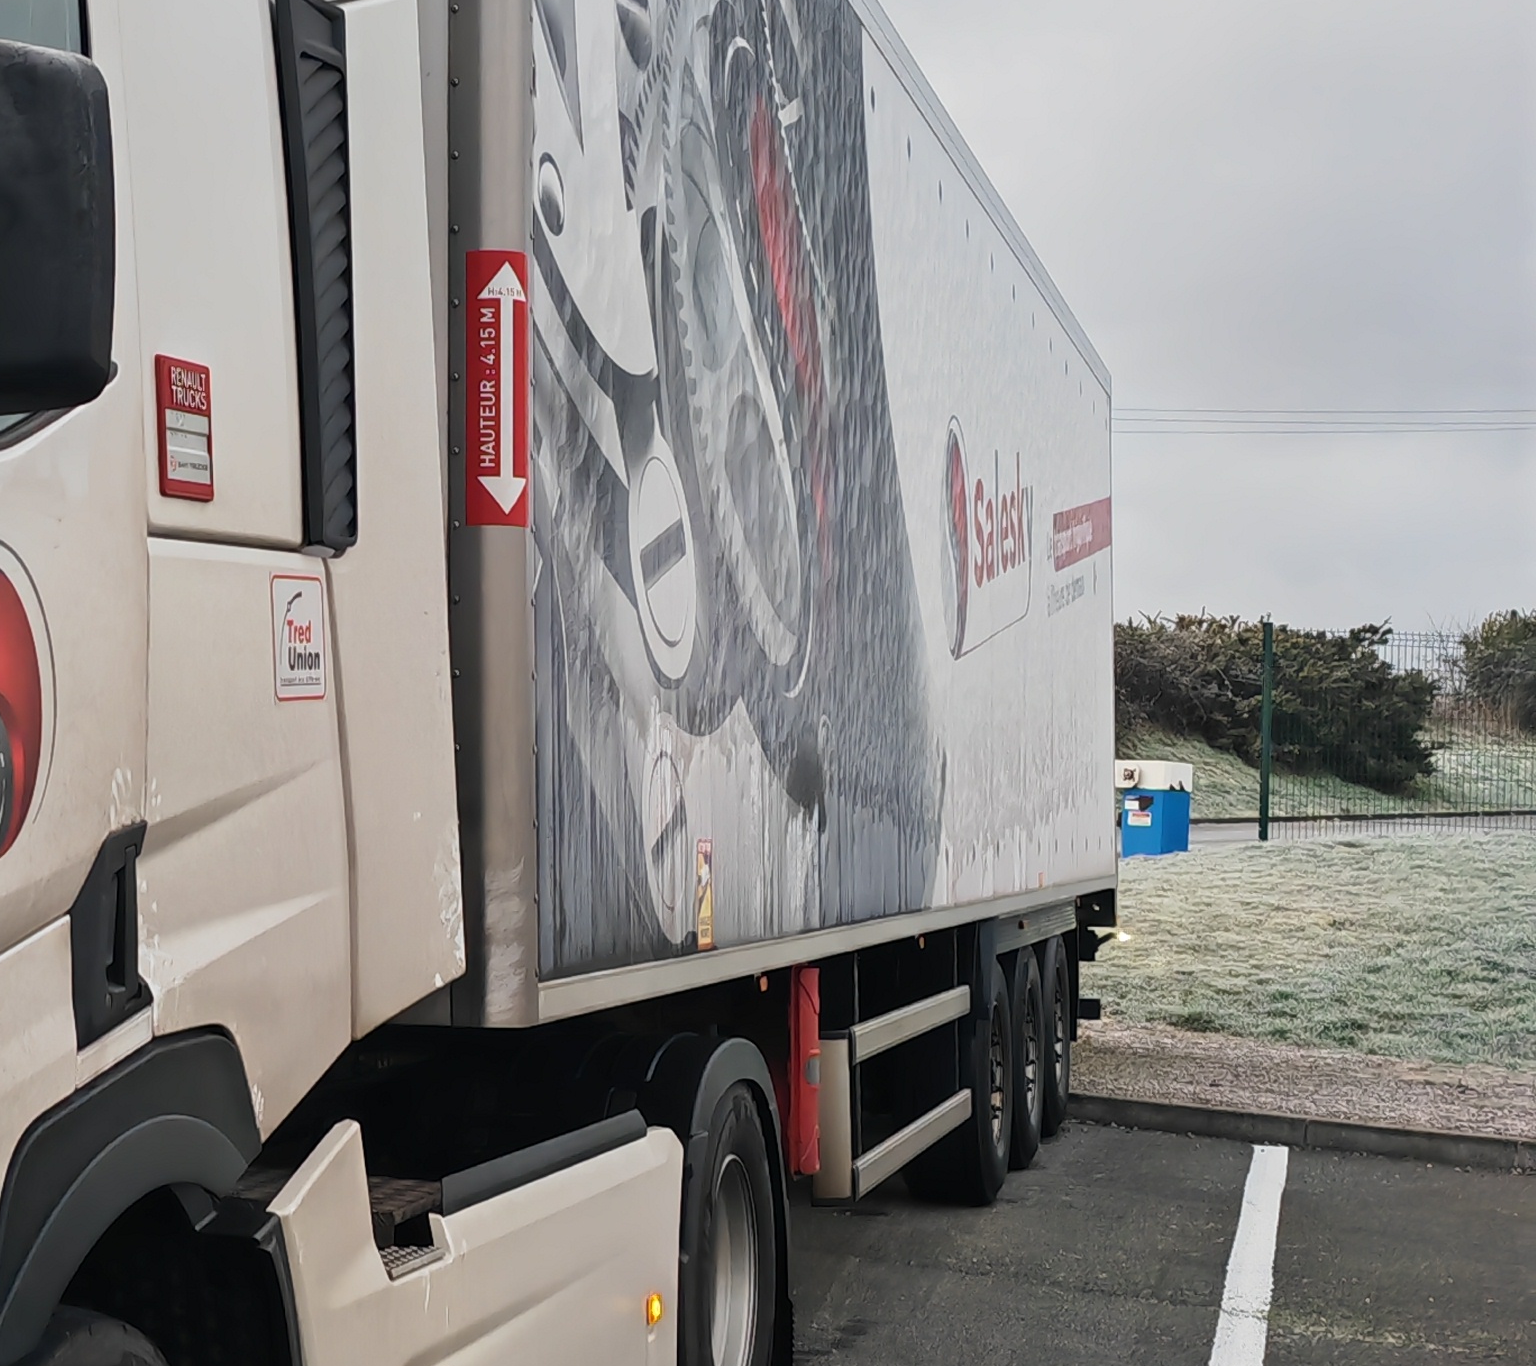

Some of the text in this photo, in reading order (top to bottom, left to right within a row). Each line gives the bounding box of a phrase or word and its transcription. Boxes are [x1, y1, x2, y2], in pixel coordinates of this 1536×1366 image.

[480, 307, 496, 324] M
[480, 327, 496, 365] 4.15
[170, 366, 207, 392] RENAULT
[171, 385, 207, 411] TRUCKS
[480, 379, 496, 468] HAUTEUR
[974, 449, 1033, 590] Salesky
[286, 619, 312, 644] Tred
[288, 645, 321, 671] Union
